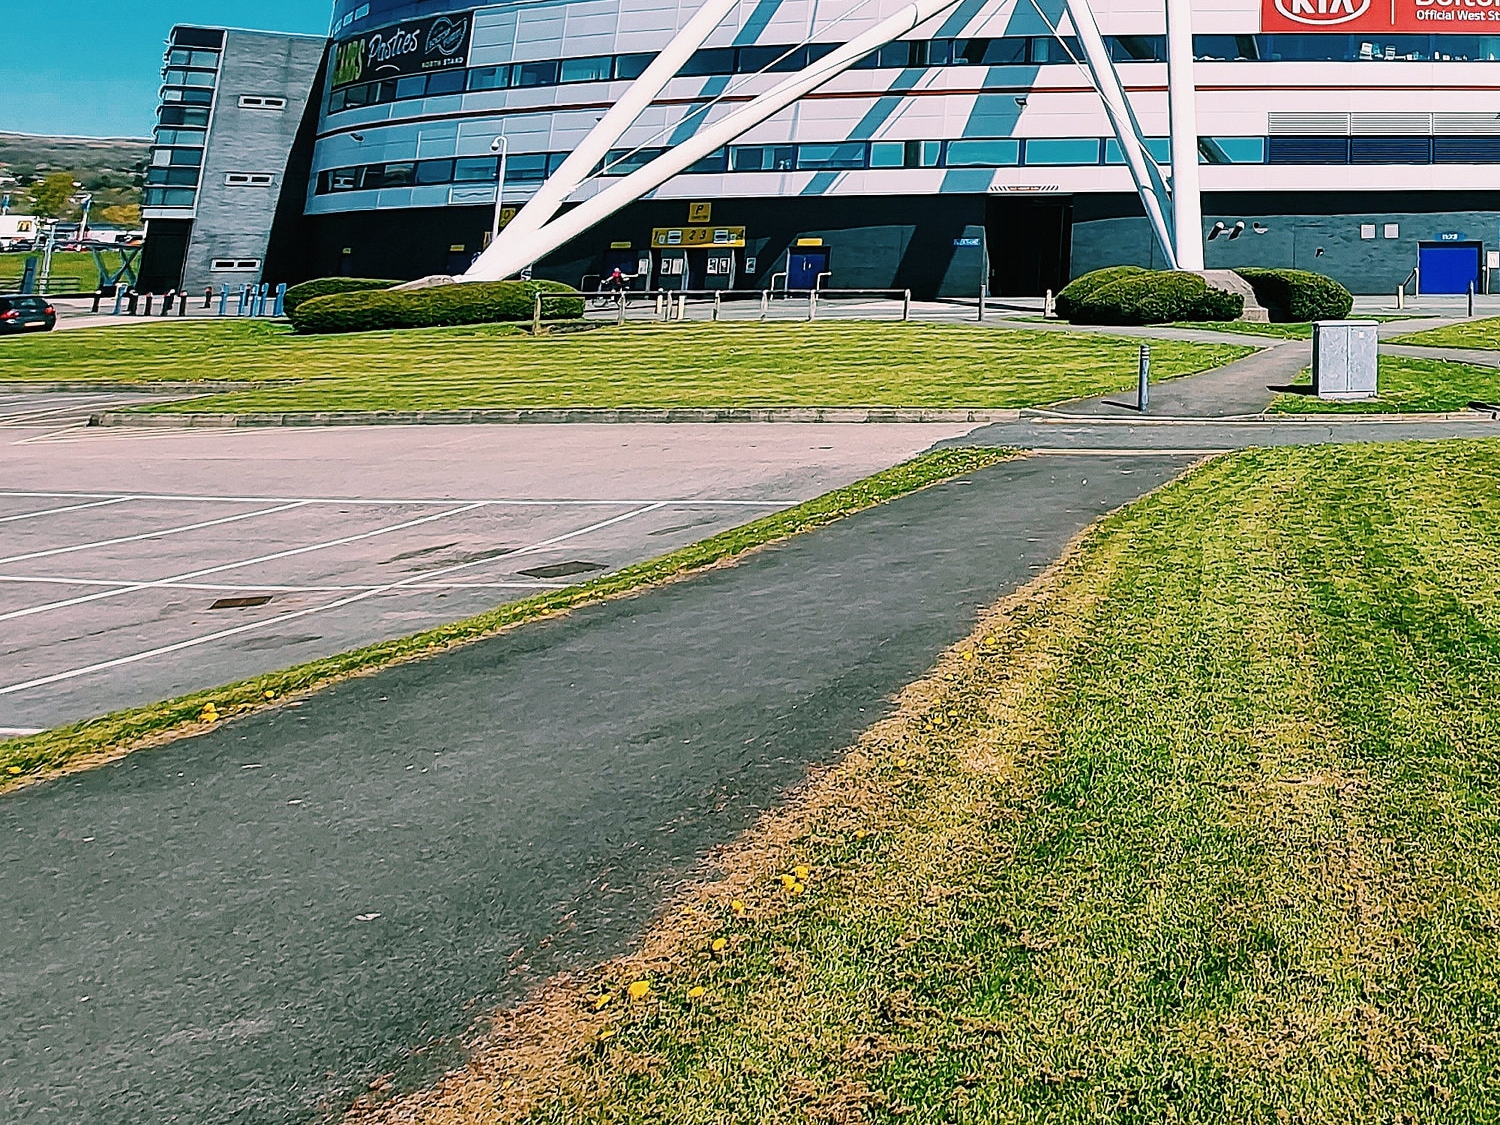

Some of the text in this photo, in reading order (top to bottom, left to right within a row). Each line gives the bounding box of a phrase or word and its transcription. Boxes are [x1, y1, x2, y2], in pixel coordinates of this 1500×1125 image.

[1416, 10, 1455, 21] Official
[1457, 10, 1486, 21] West
[367, 27, 421, 67] Pasties
